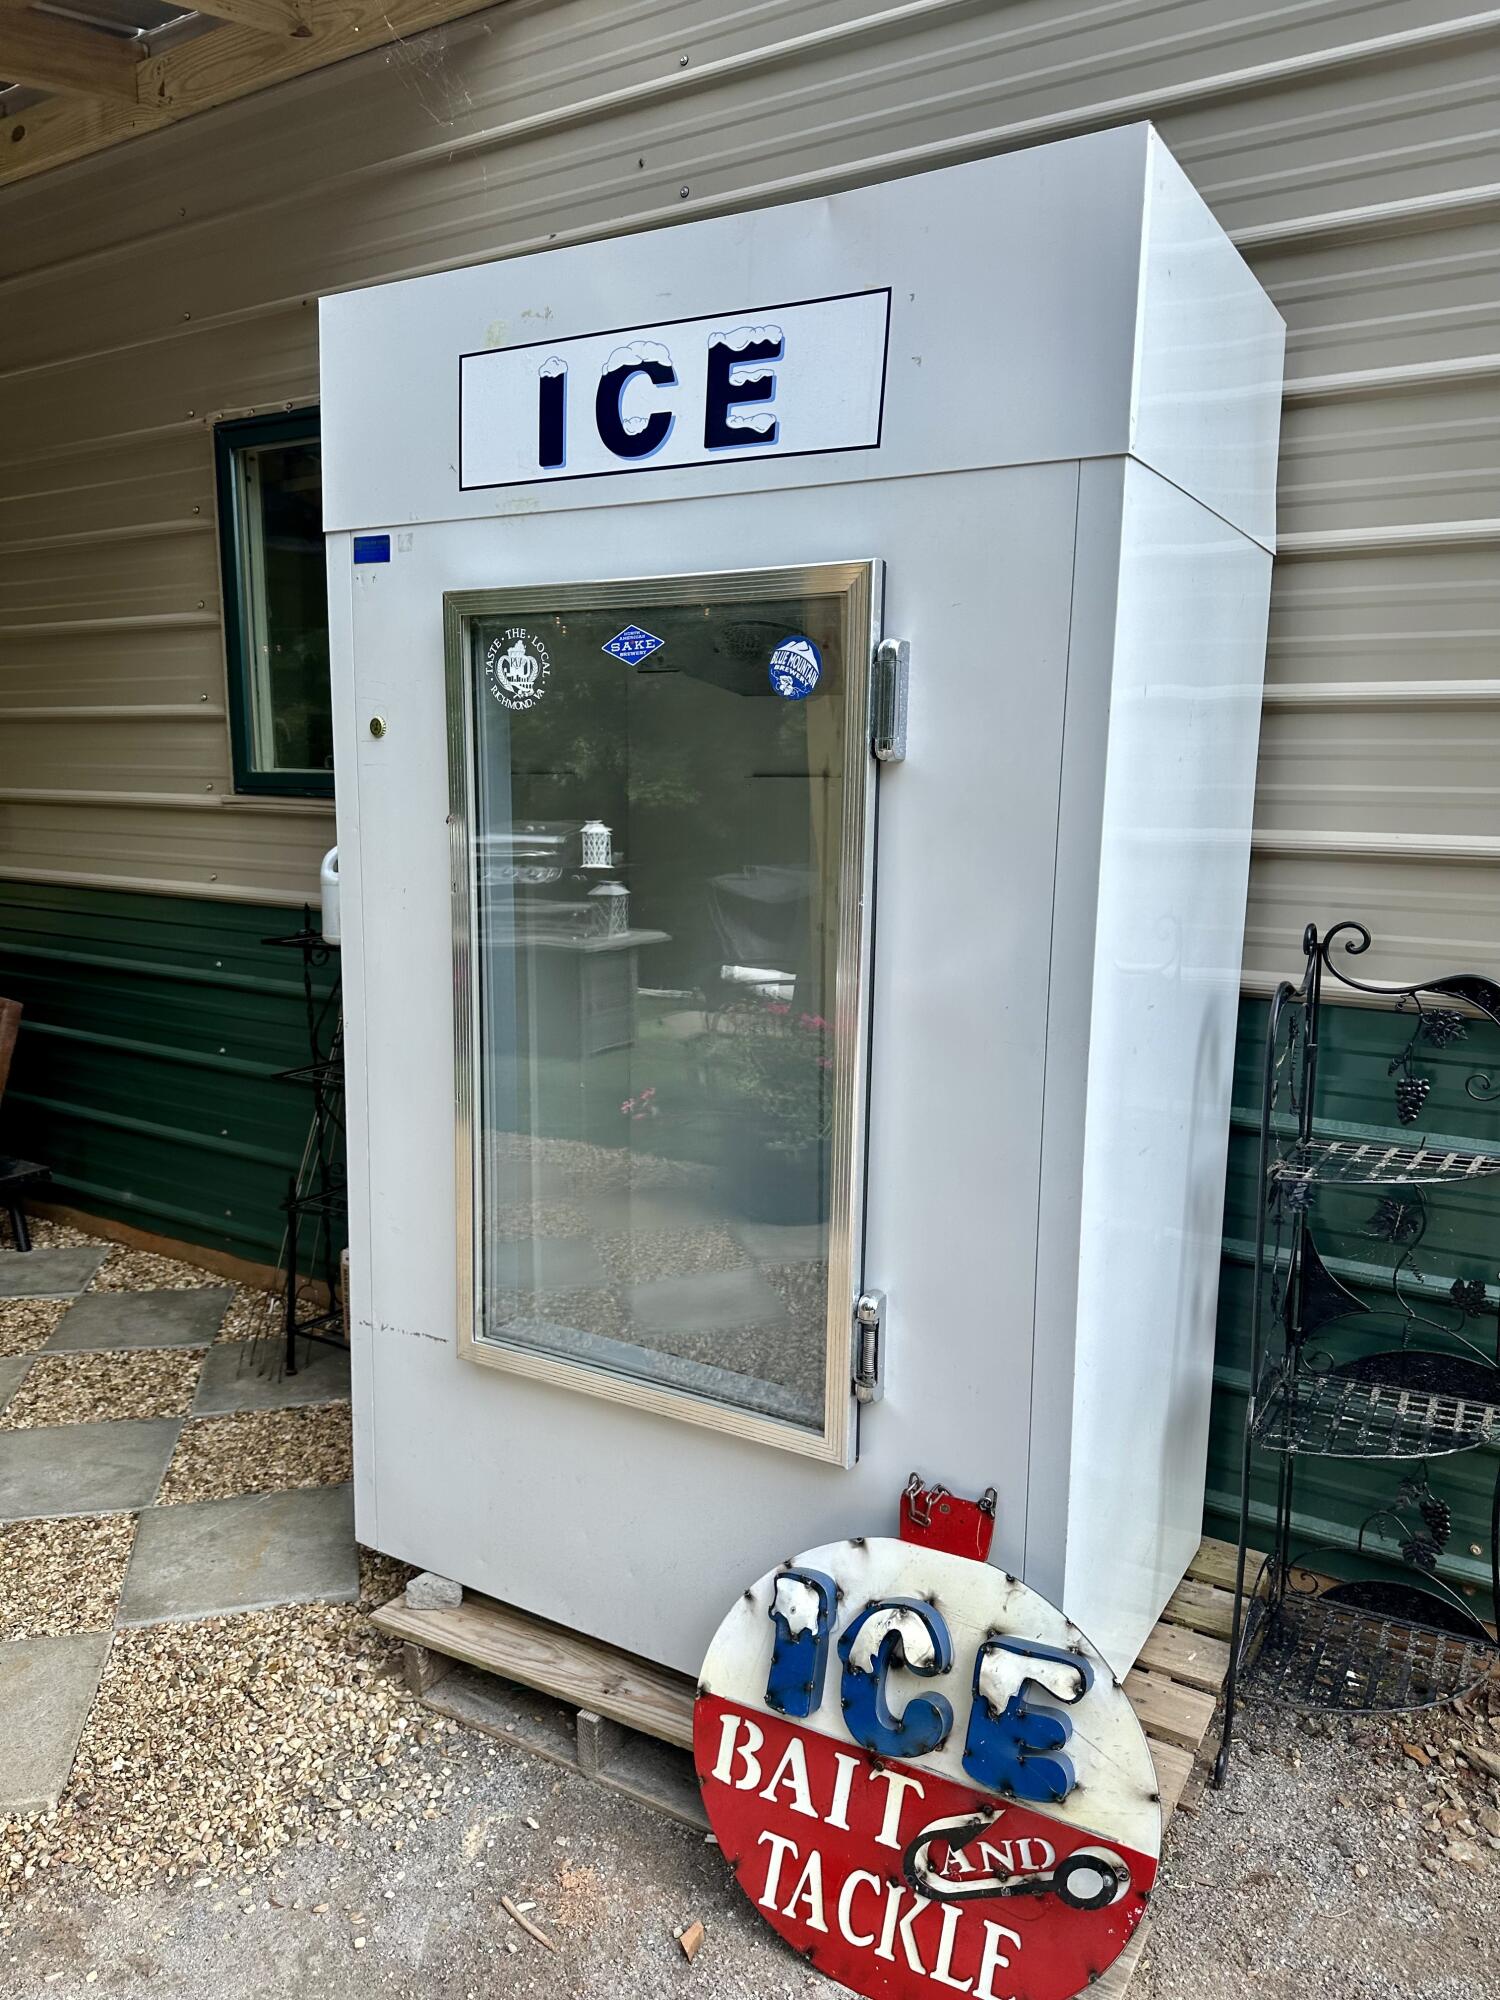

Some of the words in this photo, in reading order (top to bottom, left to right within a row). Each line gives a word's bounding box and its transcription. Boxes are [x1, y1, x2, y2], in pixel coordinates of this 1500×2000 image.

[538, 325, 785, 469] ICE
[486, 638, 502, 675] TASTE
[505, 628, 526, 639] THE
[531, 636, 550, 677] LOCAL
[611, 639, 656, 652] SAKE
[770, 650, 789, 664] BLUE
[787, 652, 818, 688] MOUNTAIN
[774, 664, 809, 687] BREWERY
[533, 688, 545, 700] VA
[764, 1567, 1094, 1803] ICE
[711, 1713, 926, 1851] BAIT
[940, 1837, 1057, 1877] AND
[757, 1830, 1022, 2000] TACKLE
